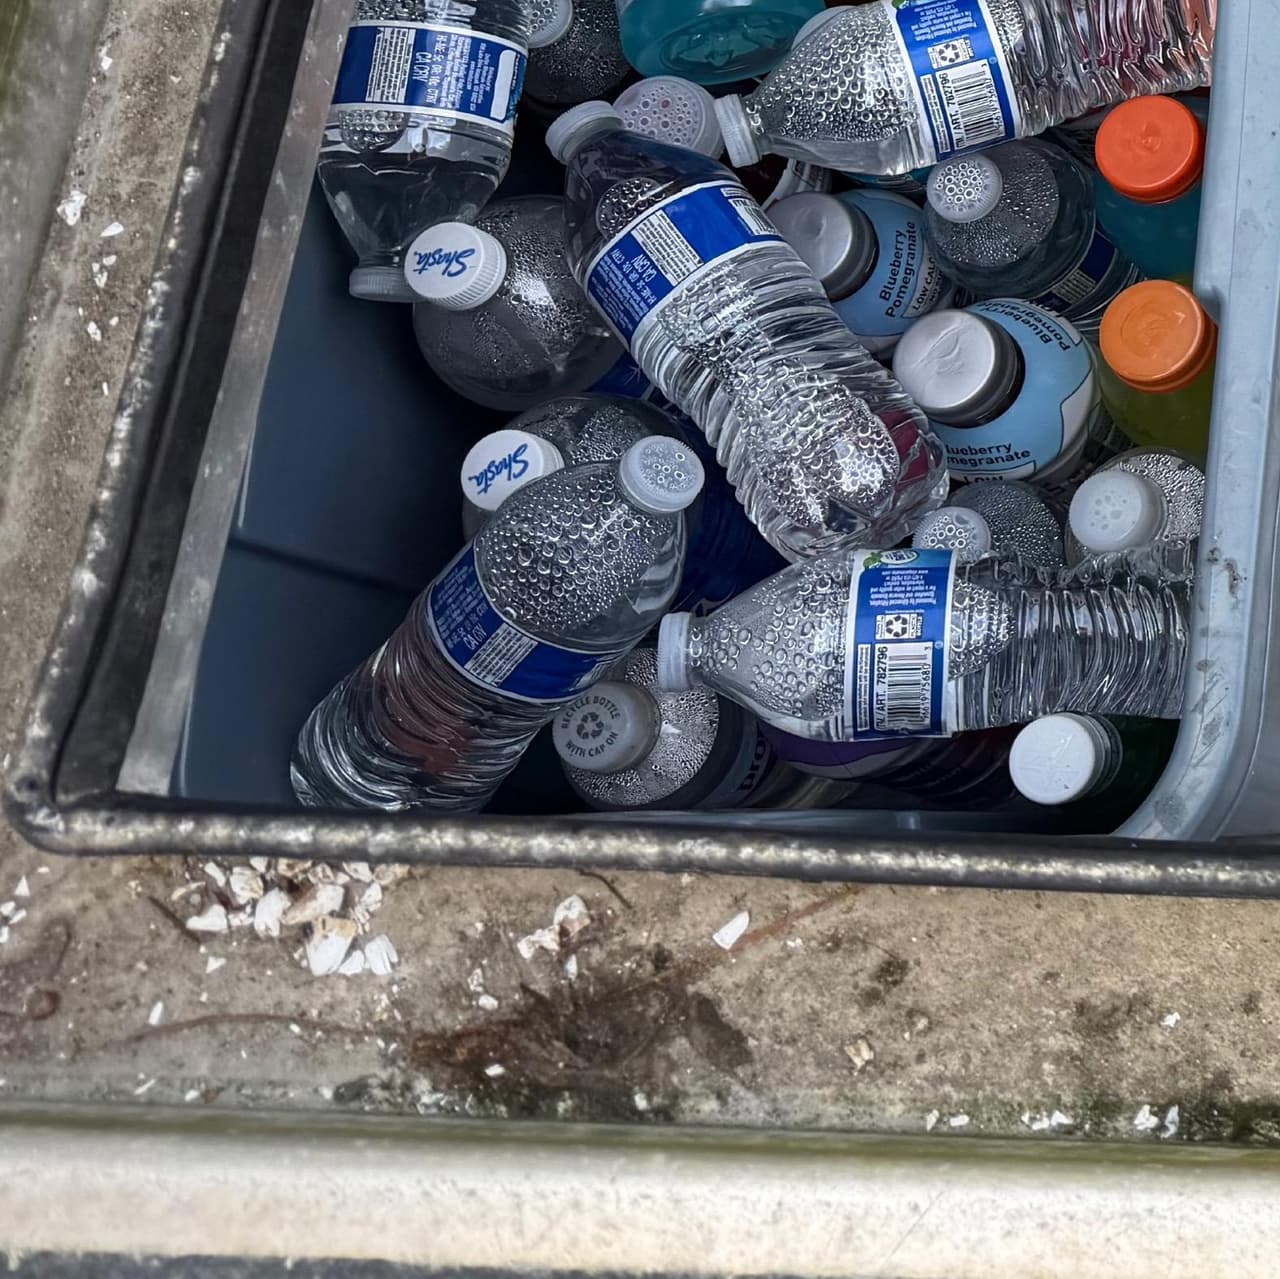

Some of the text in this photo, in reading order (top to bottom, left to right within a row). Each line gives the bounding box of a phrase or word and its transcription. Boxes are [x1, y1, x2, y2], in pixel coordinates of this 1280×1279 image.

[415, 51, 431, 63] CA
[938, 72, 956, 107] 782796
[413, 248, 475, 277] Shasta
[630, 253, 659, 283] CA CRV
[879, 229, 906, 301] Blueberry
[886, 221, 916, 318] Pomegranate
[912, 256, 938, 311] LOW CALO
[980, 306, 1053, 344] Blueberry
[946, 443, 1012, 454] lueberry
[947, 450, 1031, 469] megranate
[468, 444, 528, 495] Shasta
[877, 647, 887, 685] 782796
[560, 695, 621, 729] RECYCLE BOTTLE
[565, 732, 619, 757] WITH CAP ON
